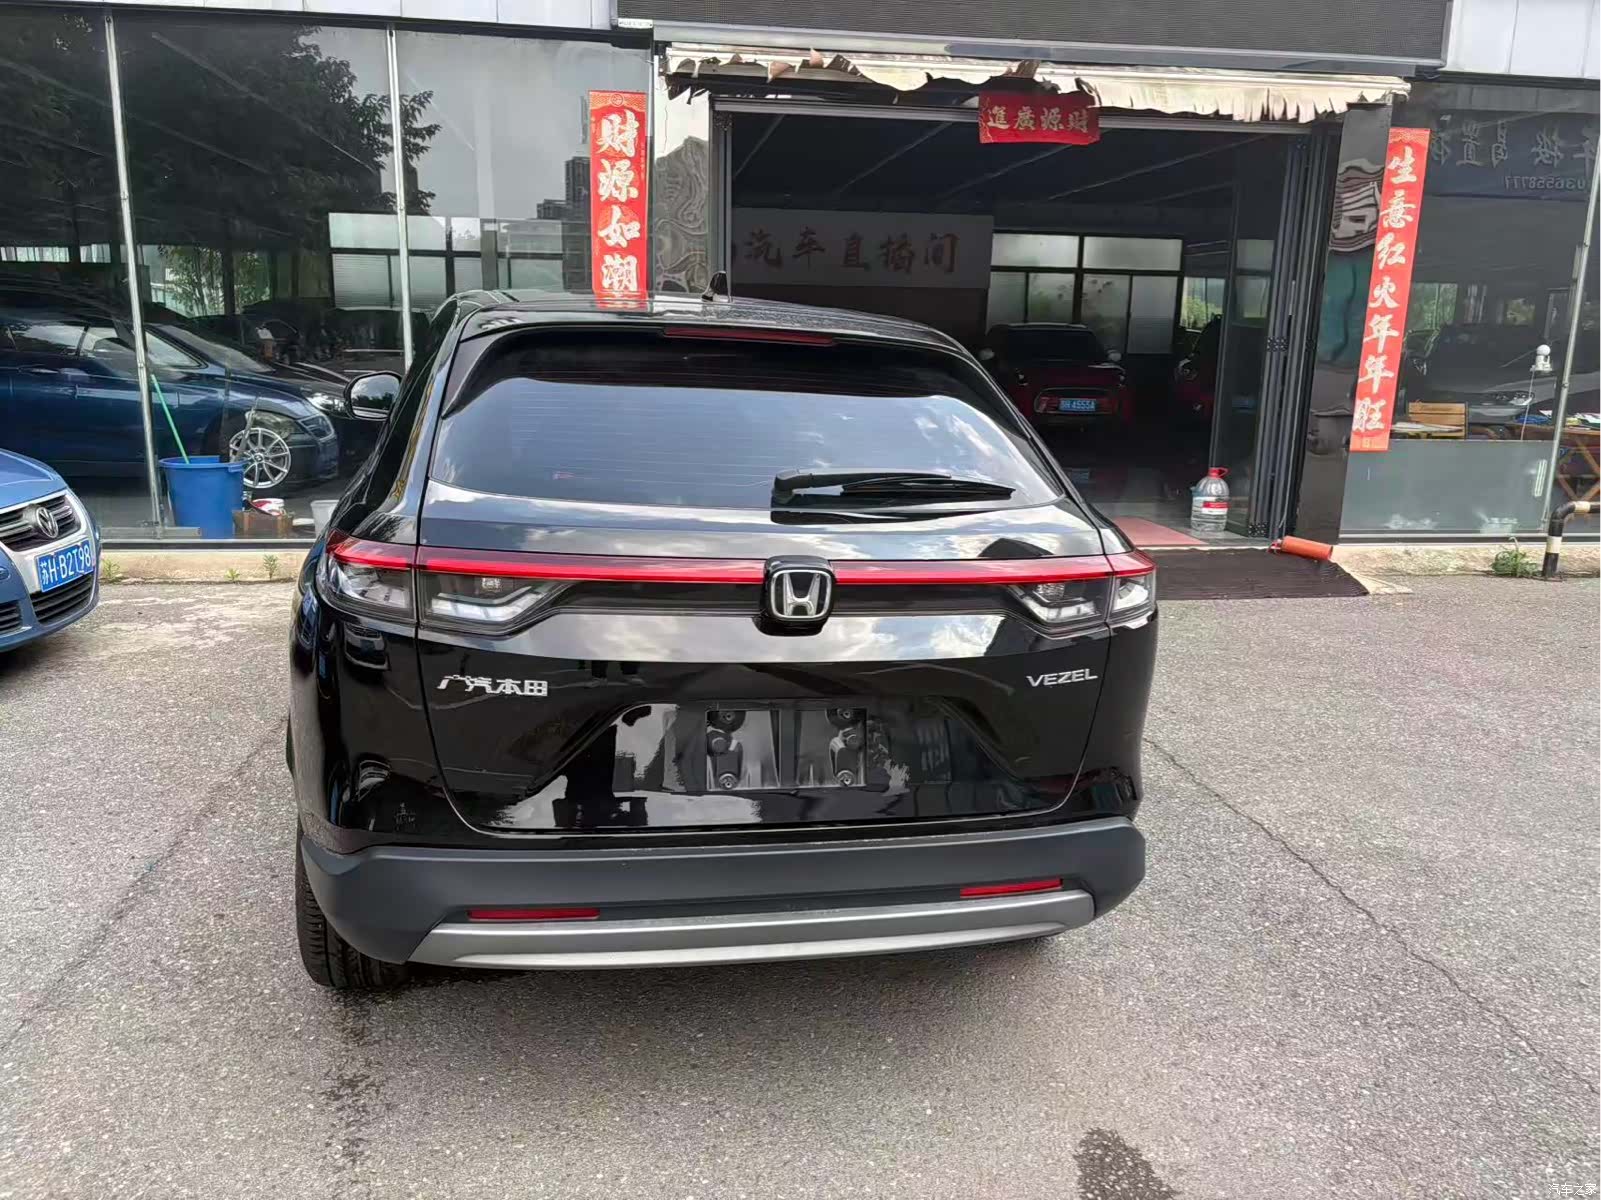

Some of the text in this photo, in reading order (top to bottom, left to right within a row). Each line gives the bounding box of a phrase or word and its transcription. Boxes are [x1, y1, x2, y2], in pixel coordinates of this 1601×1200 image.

[731, 225, 960, 275] 汽车直播间
[1352, 146, 1418, 433] 生意红火年年旺
[437, 675, 548, 696] 广汽本田
[1026, 668, 1098, 687] VEZEL
